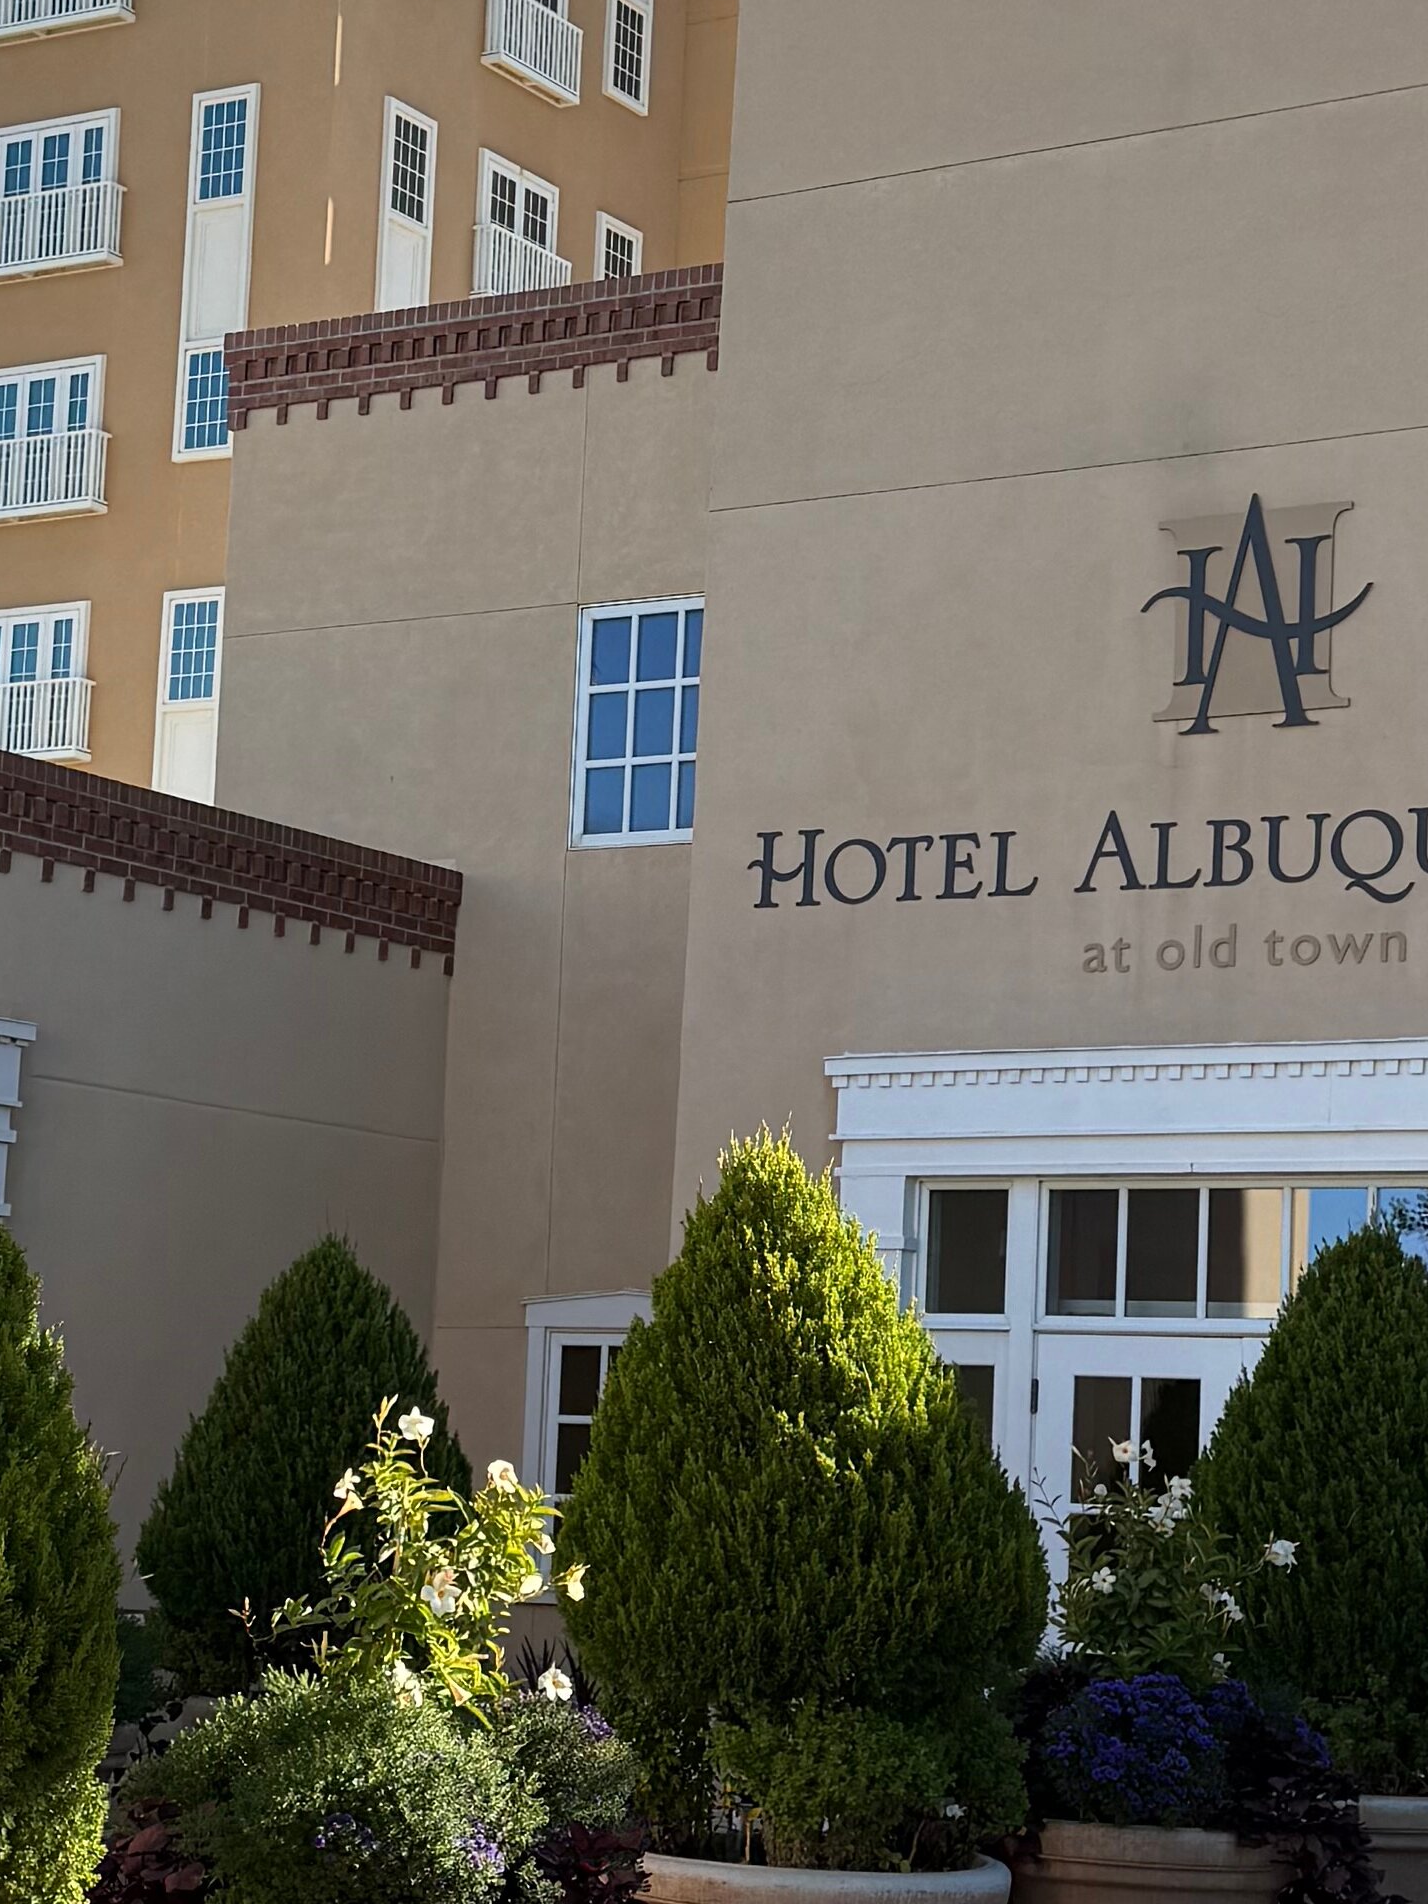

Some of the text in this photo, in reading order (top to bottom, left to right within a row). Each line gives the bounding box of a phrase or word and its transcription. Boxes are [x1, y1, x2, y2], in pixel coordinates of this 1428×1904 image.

[747, 828, 1039, 909] HOTEL
[1082, 923, 1409, 974] at old town
